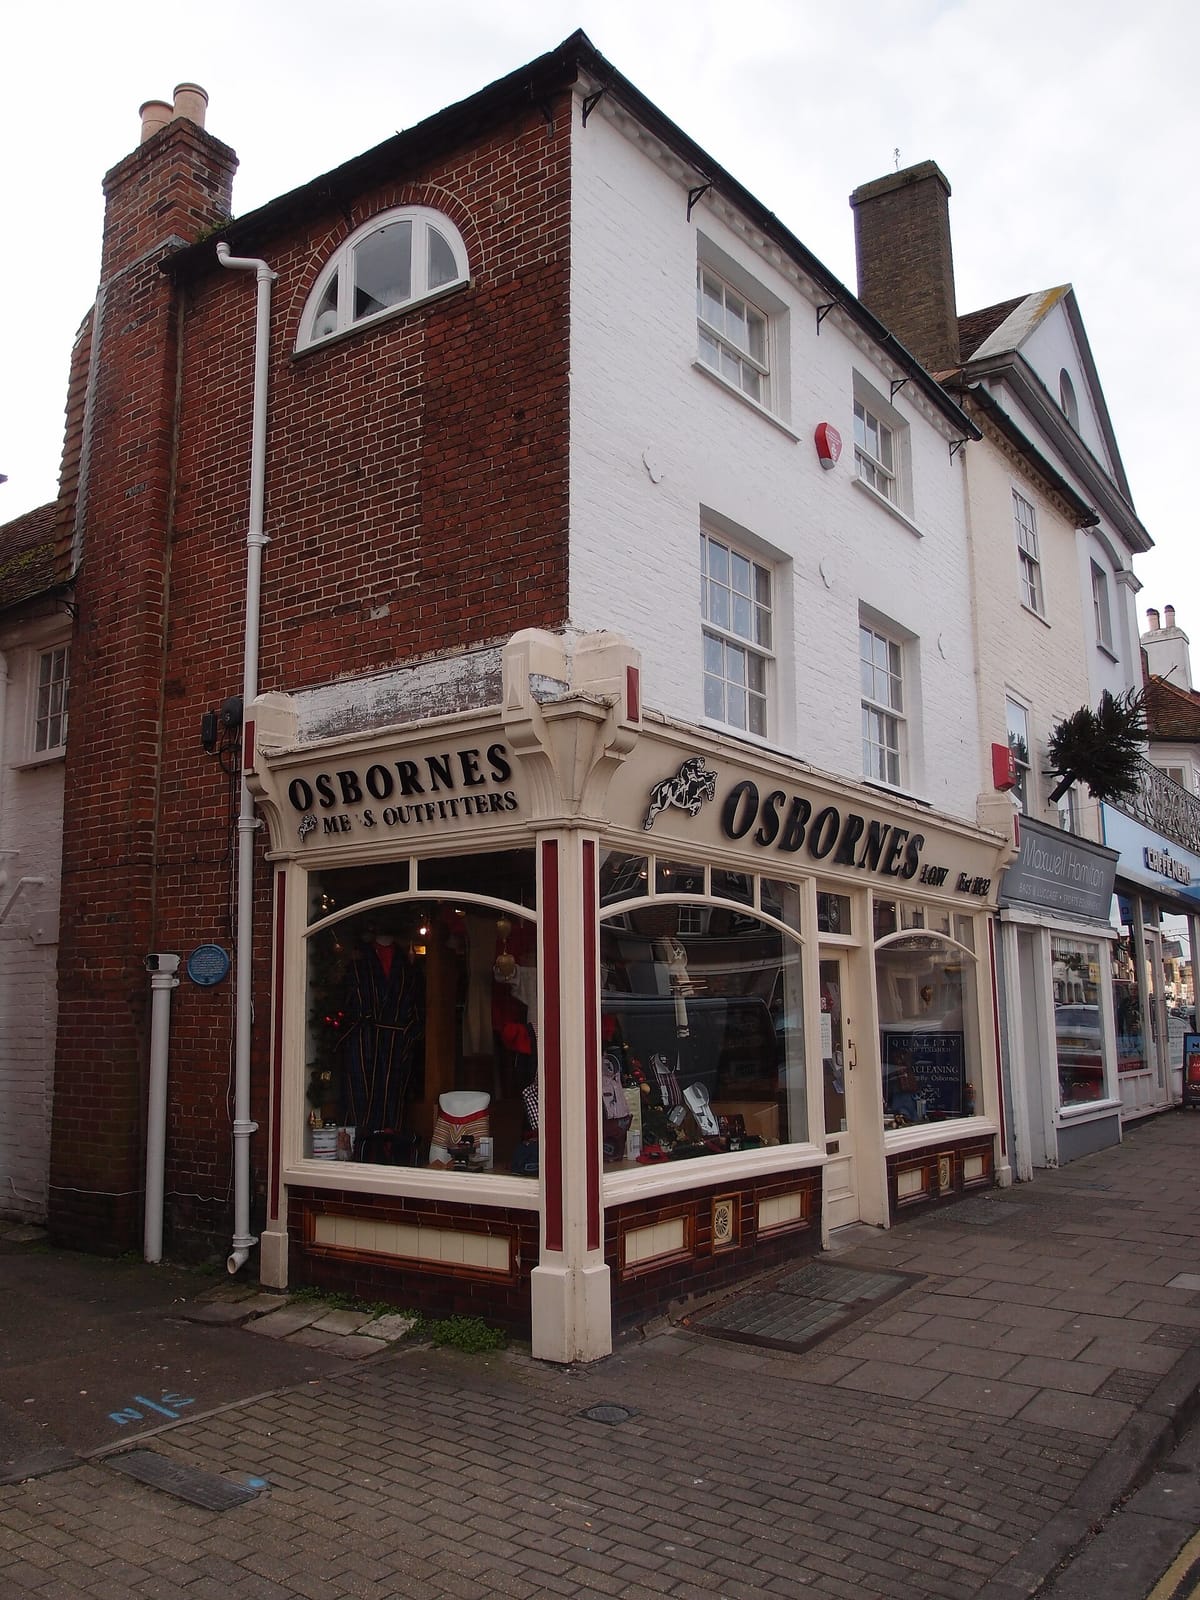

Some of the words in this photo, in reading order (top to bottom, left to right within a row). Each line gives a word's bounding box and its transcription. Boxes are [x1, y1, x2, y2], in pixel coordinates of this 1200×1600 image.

[288, 744, 512, 812] OSBORNES
[383, 791, 519, 827] OUTFITTERS
[721, 780, 927, 880] OSBORNES
[892, 1039, 957, 1048] QUALITY
